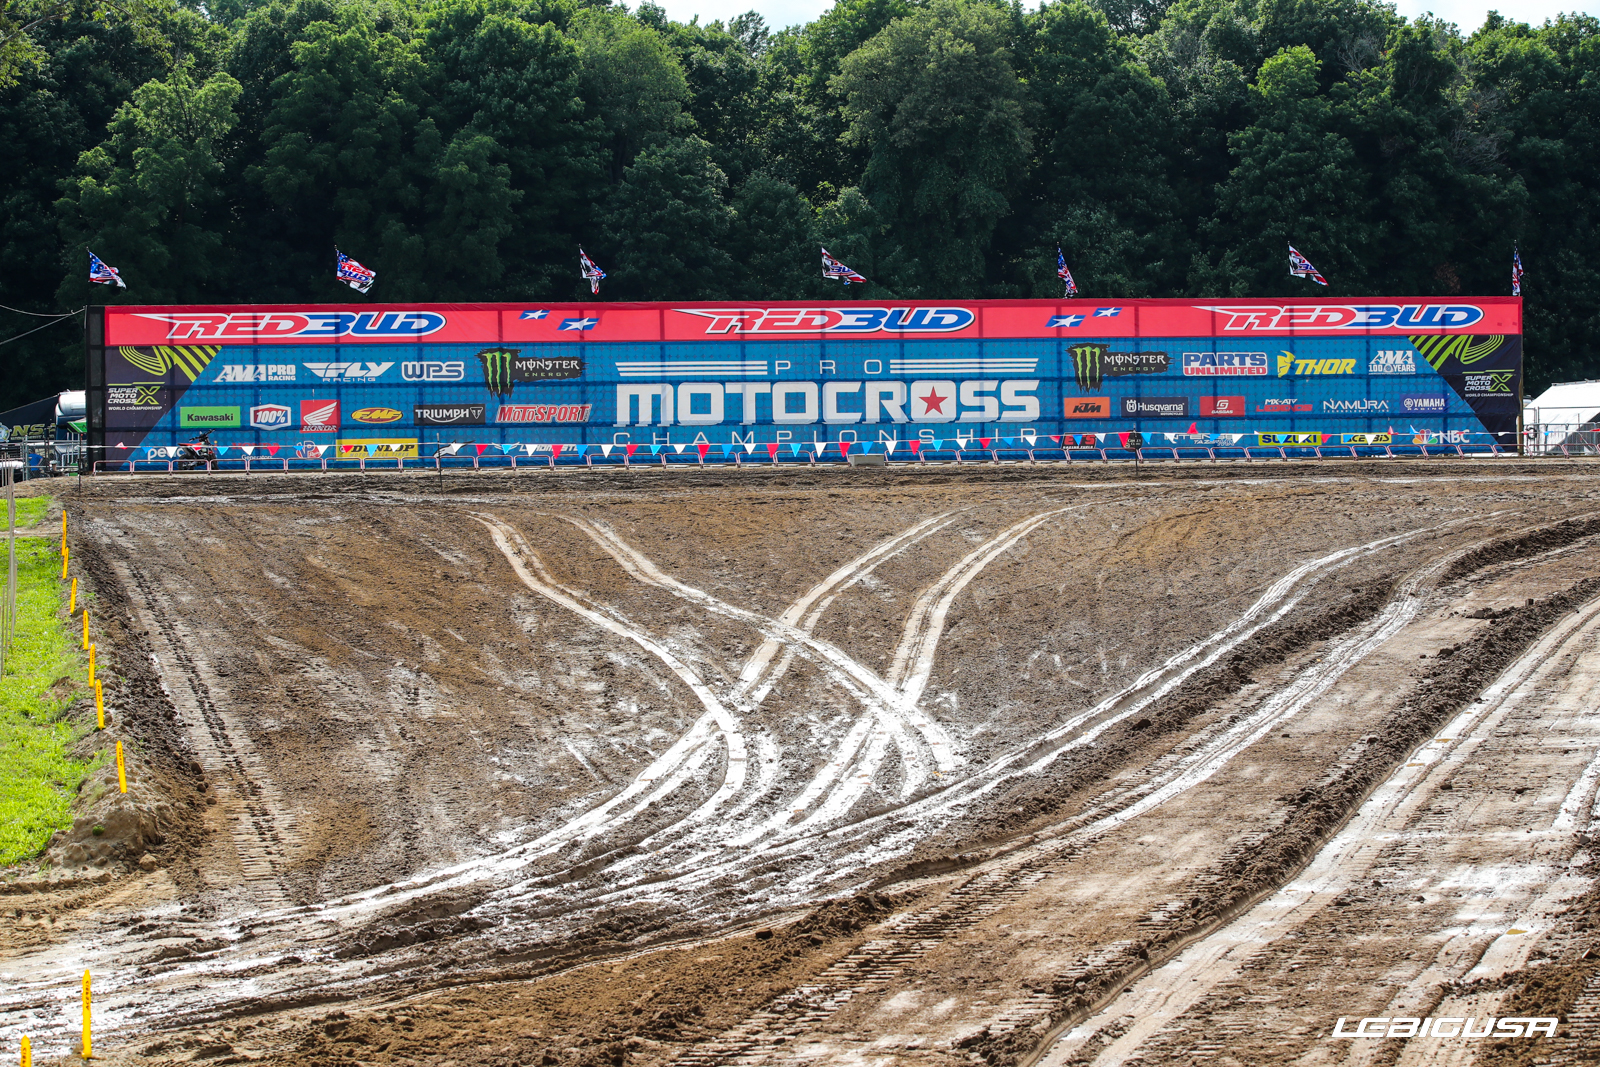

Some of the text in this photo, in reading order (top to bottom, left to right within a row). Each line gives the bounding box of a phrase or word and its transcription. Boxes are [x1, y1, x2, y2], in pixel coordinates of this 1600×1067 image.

[671, 307, 976, 334] REDBUD
[1191, 304, 1484, 330] REDBUD
[131, 311, 447, 339] REDBUD
[1104, 353, 1166, 365] MONSTER
[1183, 352, 1268, 367] PARTS
[1368, 350, 1415, 364] AMA
[303, 362, 396, 378] FLY
[401, 361, 465, 381] WPS
[515, 358, 580, 371] MONSTER
[775, 359, 883, 375] PRO
[1184, 366, 1267, 376] UNLIMITED
[1294, 358, 1356, 374] THOR
[1368, 364, 1416, 372] 100 YEARS
[212, 364, 296, 382] AMA PRO
[613, 380, 1040, 427] MOTOCROSS
[1073, 403, 1102, 413] KTM
[1138, 402, 1184, 412] Husqvarna
[1256, 404, 1313, 412] LEGENDS
[1323, 398, 1389, 409] NAMURA
[1413, 398, 1445, 407] YAMAHA
[187, 413, 234, 422] Kawasaki
[256, 410, 286, 423] 100%
[352, 409, 403, 420] FMF
[415, 408, 470, 419] TRIUMPH
[613, 428, 1036, 447] CHAMPIONSHIP
[1440, 429, 1470, 443] NBC
